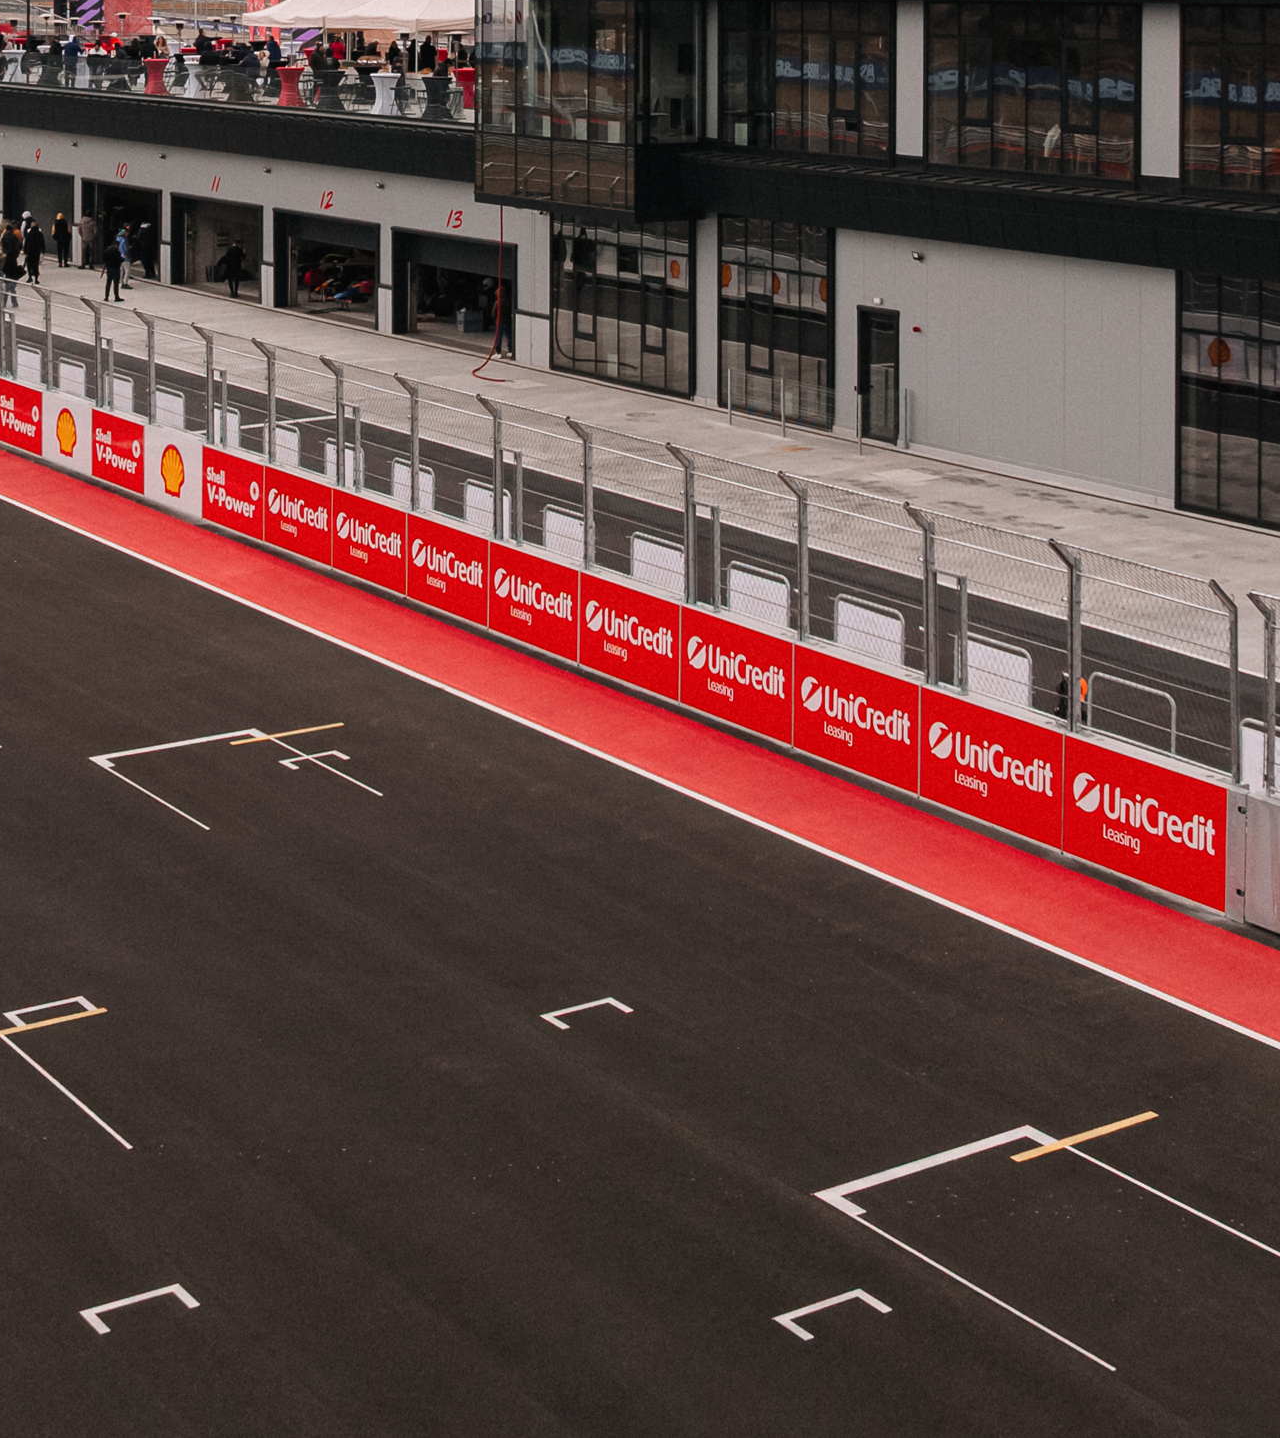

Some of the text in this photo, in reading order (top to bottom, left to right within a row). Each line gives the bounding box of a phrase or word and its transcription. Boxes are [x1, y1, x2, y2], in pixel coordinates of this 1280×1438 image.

[34, 147, 42, 163] 9
[115, 162, 128, 179] 10
[210, 174, 221, 194] 11
[320, 190, 334, 210] 12
[446, 209, 463, 229] 13
[0, 394, 15, 413] Shell
[0, 410, 37, 438] V-Power
[95, 427, 112, 446] Shell
[96, 442, 138, 475] V-Power
[206, 466, 226, 487] Shell
[207, 485, 256, 520] V-Power
[280, 493, 329, 532] UniCredit
[349, 518, 402, 559] UniCredit
[427, 544, 484, 589] UniCredit
[510, 573, 573, 622] UniCredit
[509, 605, 533, 626] Leasing
[603, 606, 674, 659] UniCredit
[603, 639, 628, 662] Leasing
[707, 643, 786, 700] UniCredit
[707, 677, 734, 702] Leasing
[824, 684, 912, 745] UniCredit
[823, 720, 854, 747] Leasing
[954, 731, 1054, 798] UniCredit
[954, 769, 988, 798] Leasing
[1102, 782, 1216, 856] UniCredit
[1102, 822, 1141, 855] Leasing
